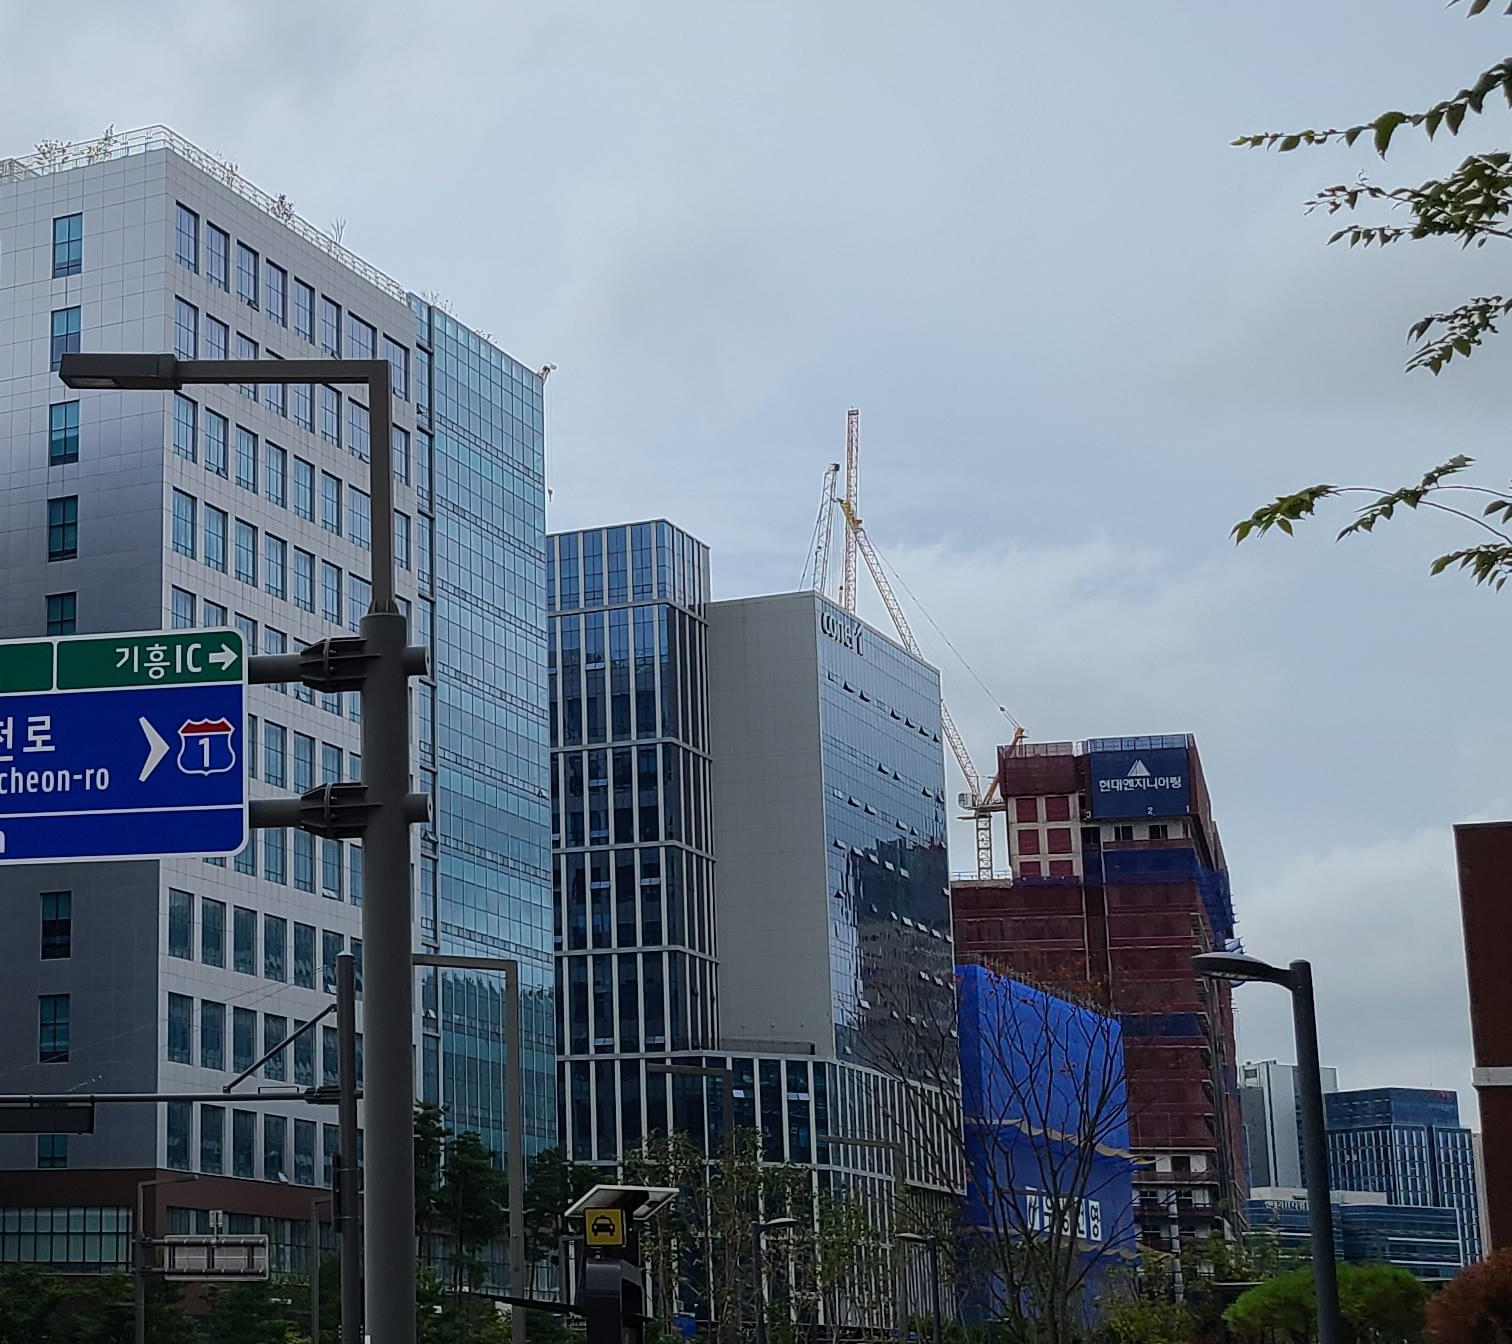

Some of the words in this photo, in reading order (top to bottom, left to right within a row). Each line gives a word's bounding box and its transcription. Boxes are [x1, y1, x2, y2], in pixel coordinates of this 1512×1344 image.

[116, 643, 201, 679] 기흥IC
[199, 739, 210, 767] 1
[1099, 776, 1182, 792] 현대엔지니어링
